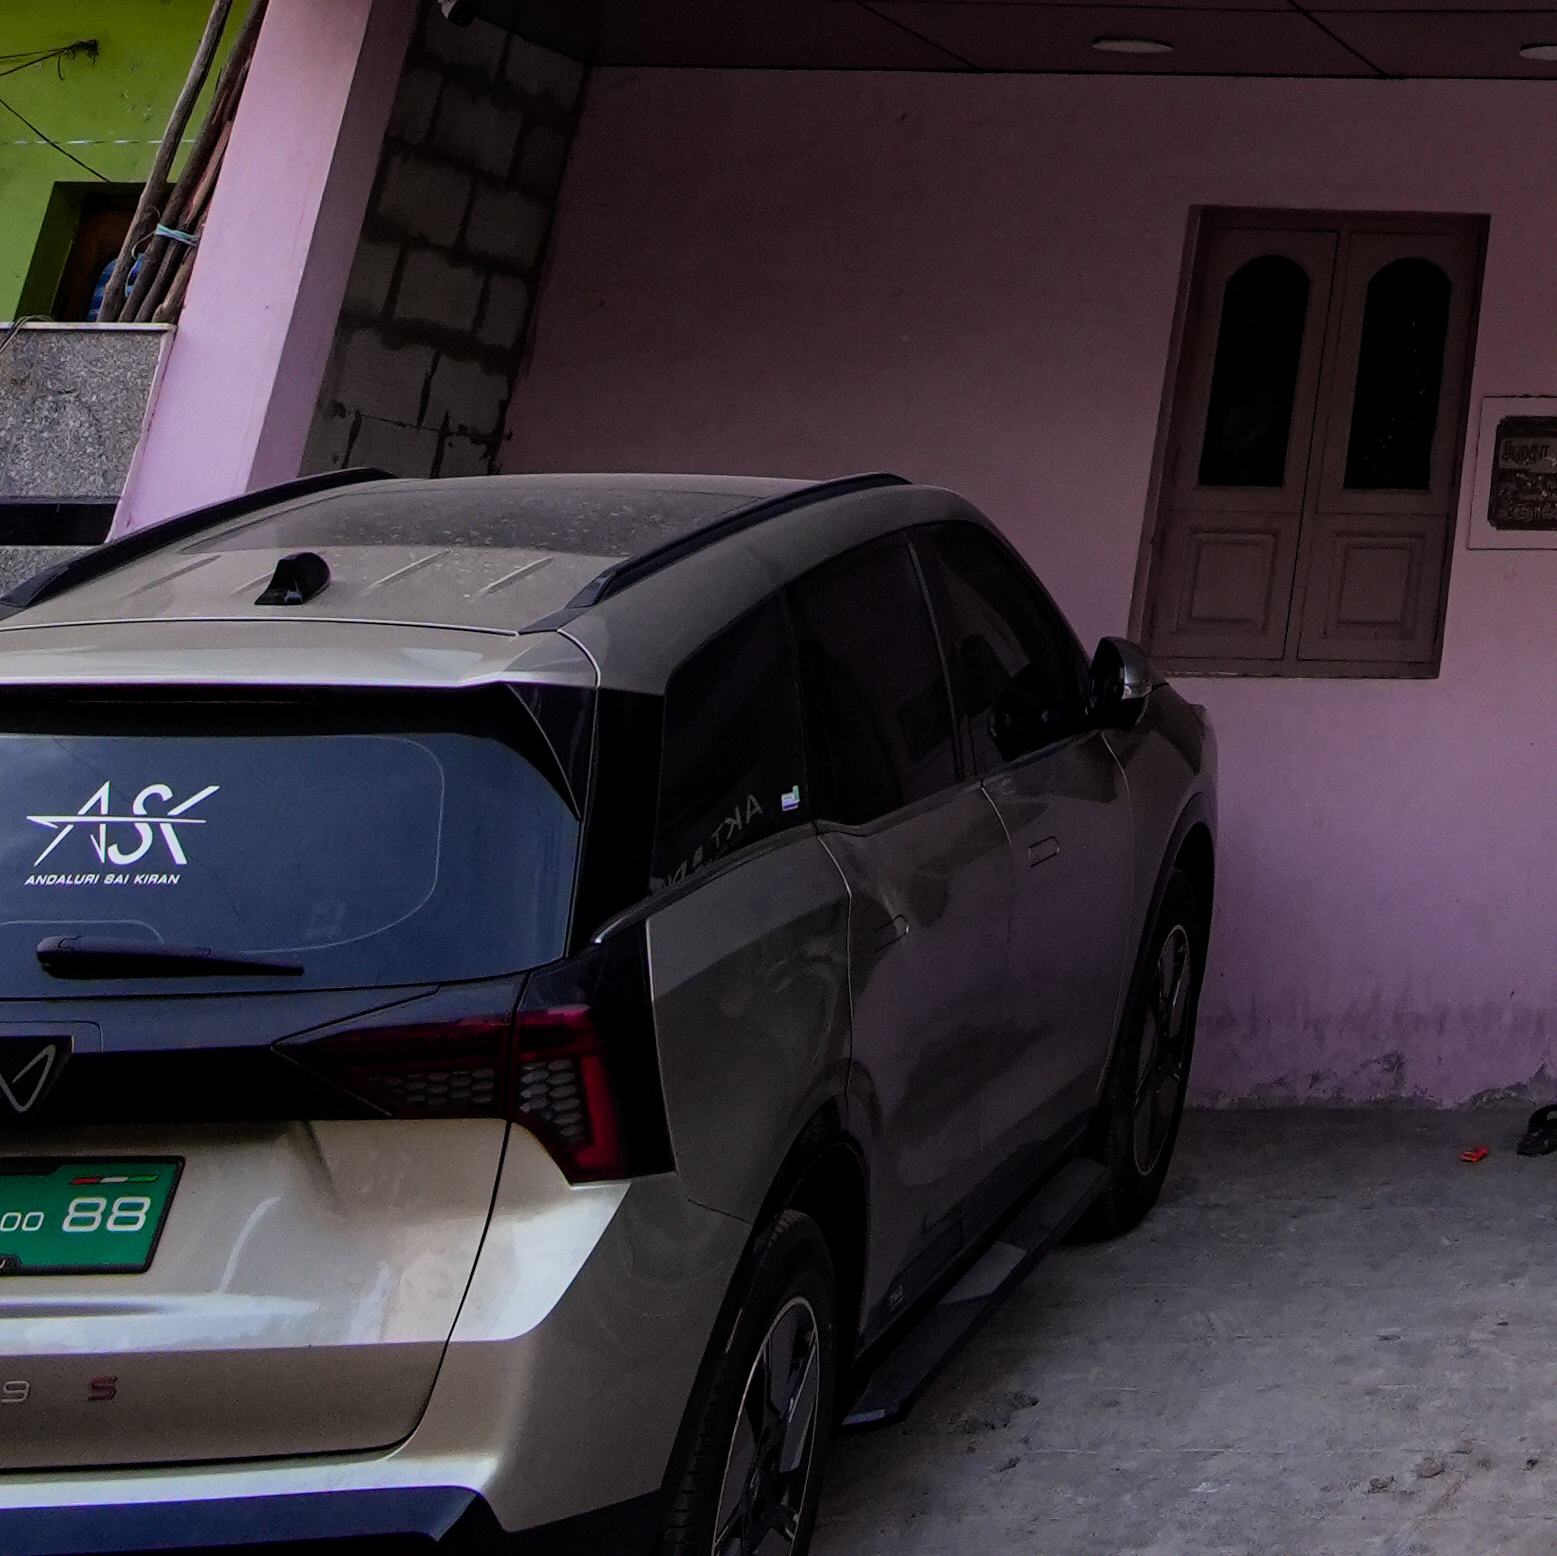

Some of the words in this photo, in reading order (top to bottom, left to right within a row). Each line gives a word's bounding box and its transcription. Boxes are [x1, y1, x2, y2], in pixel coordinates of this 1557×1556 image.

[24, 874, 100, 886] ANDALURI
[133, 874, 181, 885] KIRAN
[62, 1196, 151, 1233] 88
